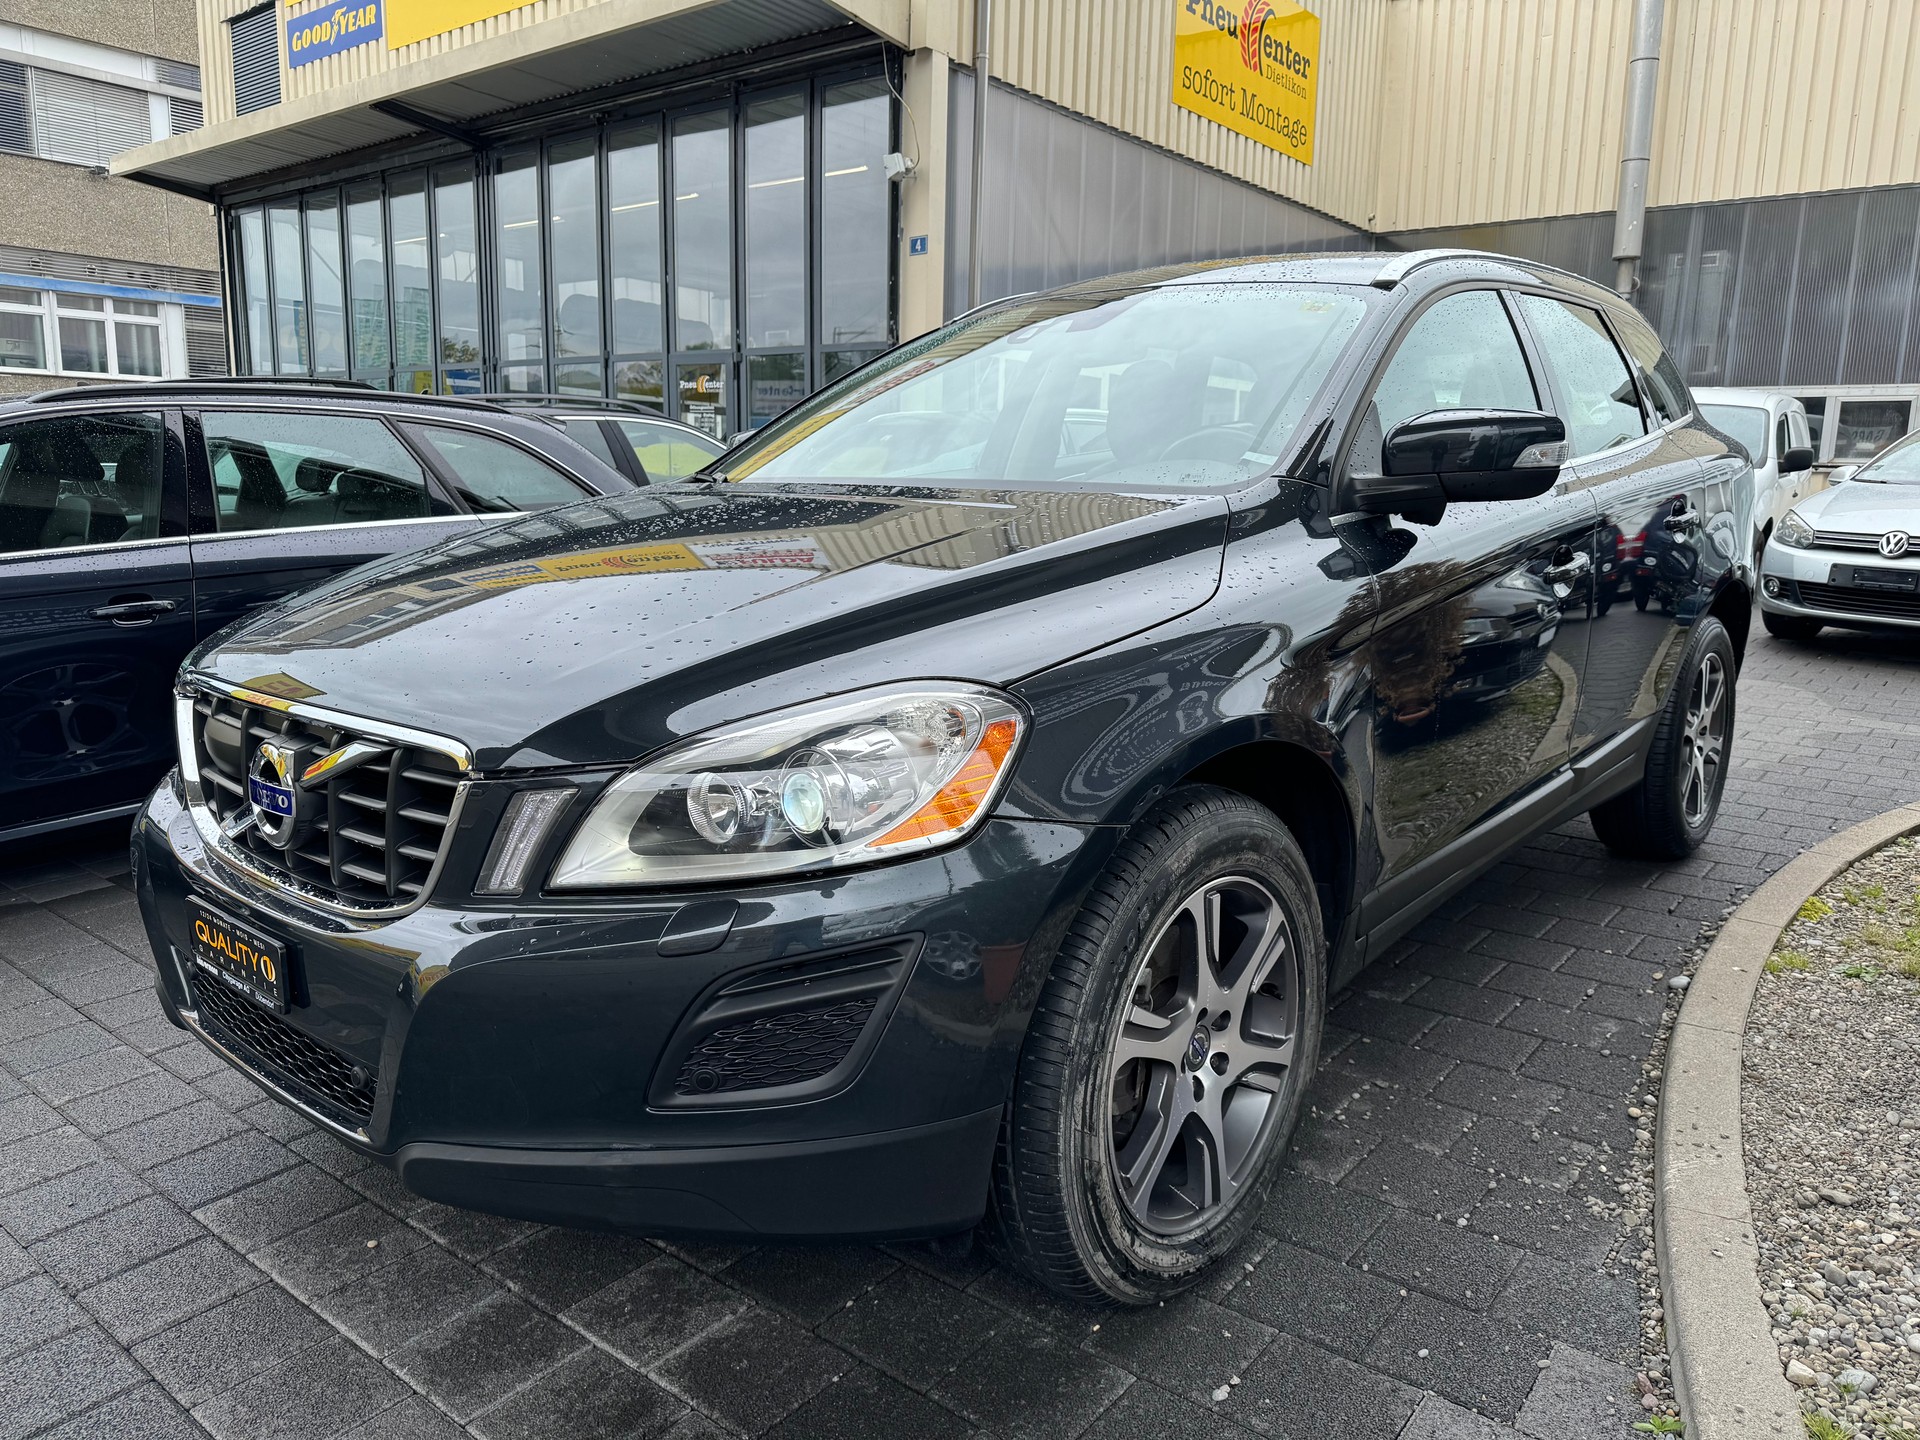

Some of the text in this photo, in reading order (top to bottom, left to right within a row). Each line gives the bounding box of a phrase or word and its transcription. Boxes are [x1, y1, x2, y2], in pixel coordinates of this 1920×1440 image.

[292, 4, 376, 52] GOODYEAR
[1265, 64, 1307, 100] Dietlikon
[1239, 87, 1307, 148] Montage
[915, 239, 921, 252] 4
